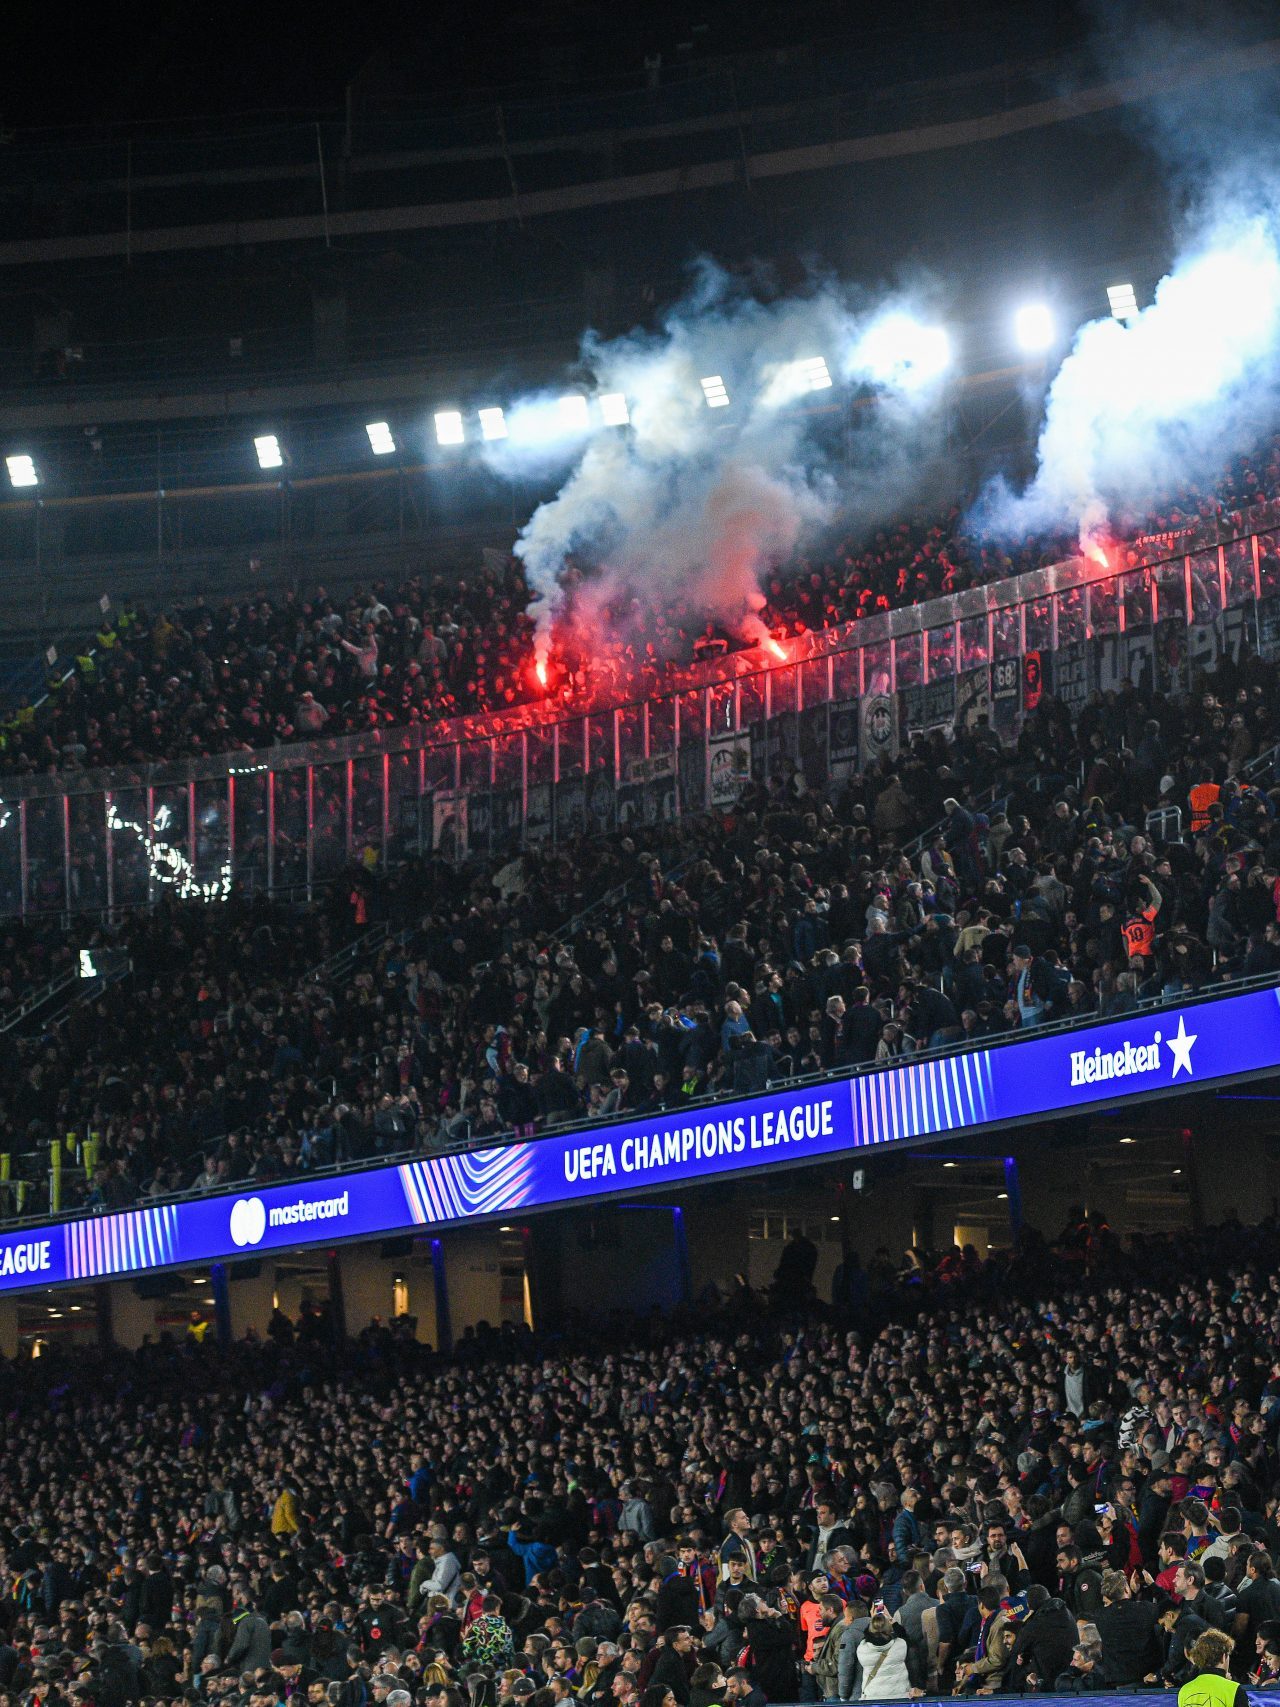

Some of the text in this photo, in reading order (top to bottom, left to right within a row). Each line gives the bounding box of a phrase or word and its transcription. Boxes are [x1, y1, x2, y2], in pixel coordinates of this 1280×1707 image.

[998, 664, 1012, 686] 68
[1070, 1041, 1161, 1087] Heineken
[565, 1101, 834, 1182] UEFA CHAMPIONS LEAGUE
[270, 1190, 349, 1226] mastercard
[0, 1241, 51, 1276] AGUE
